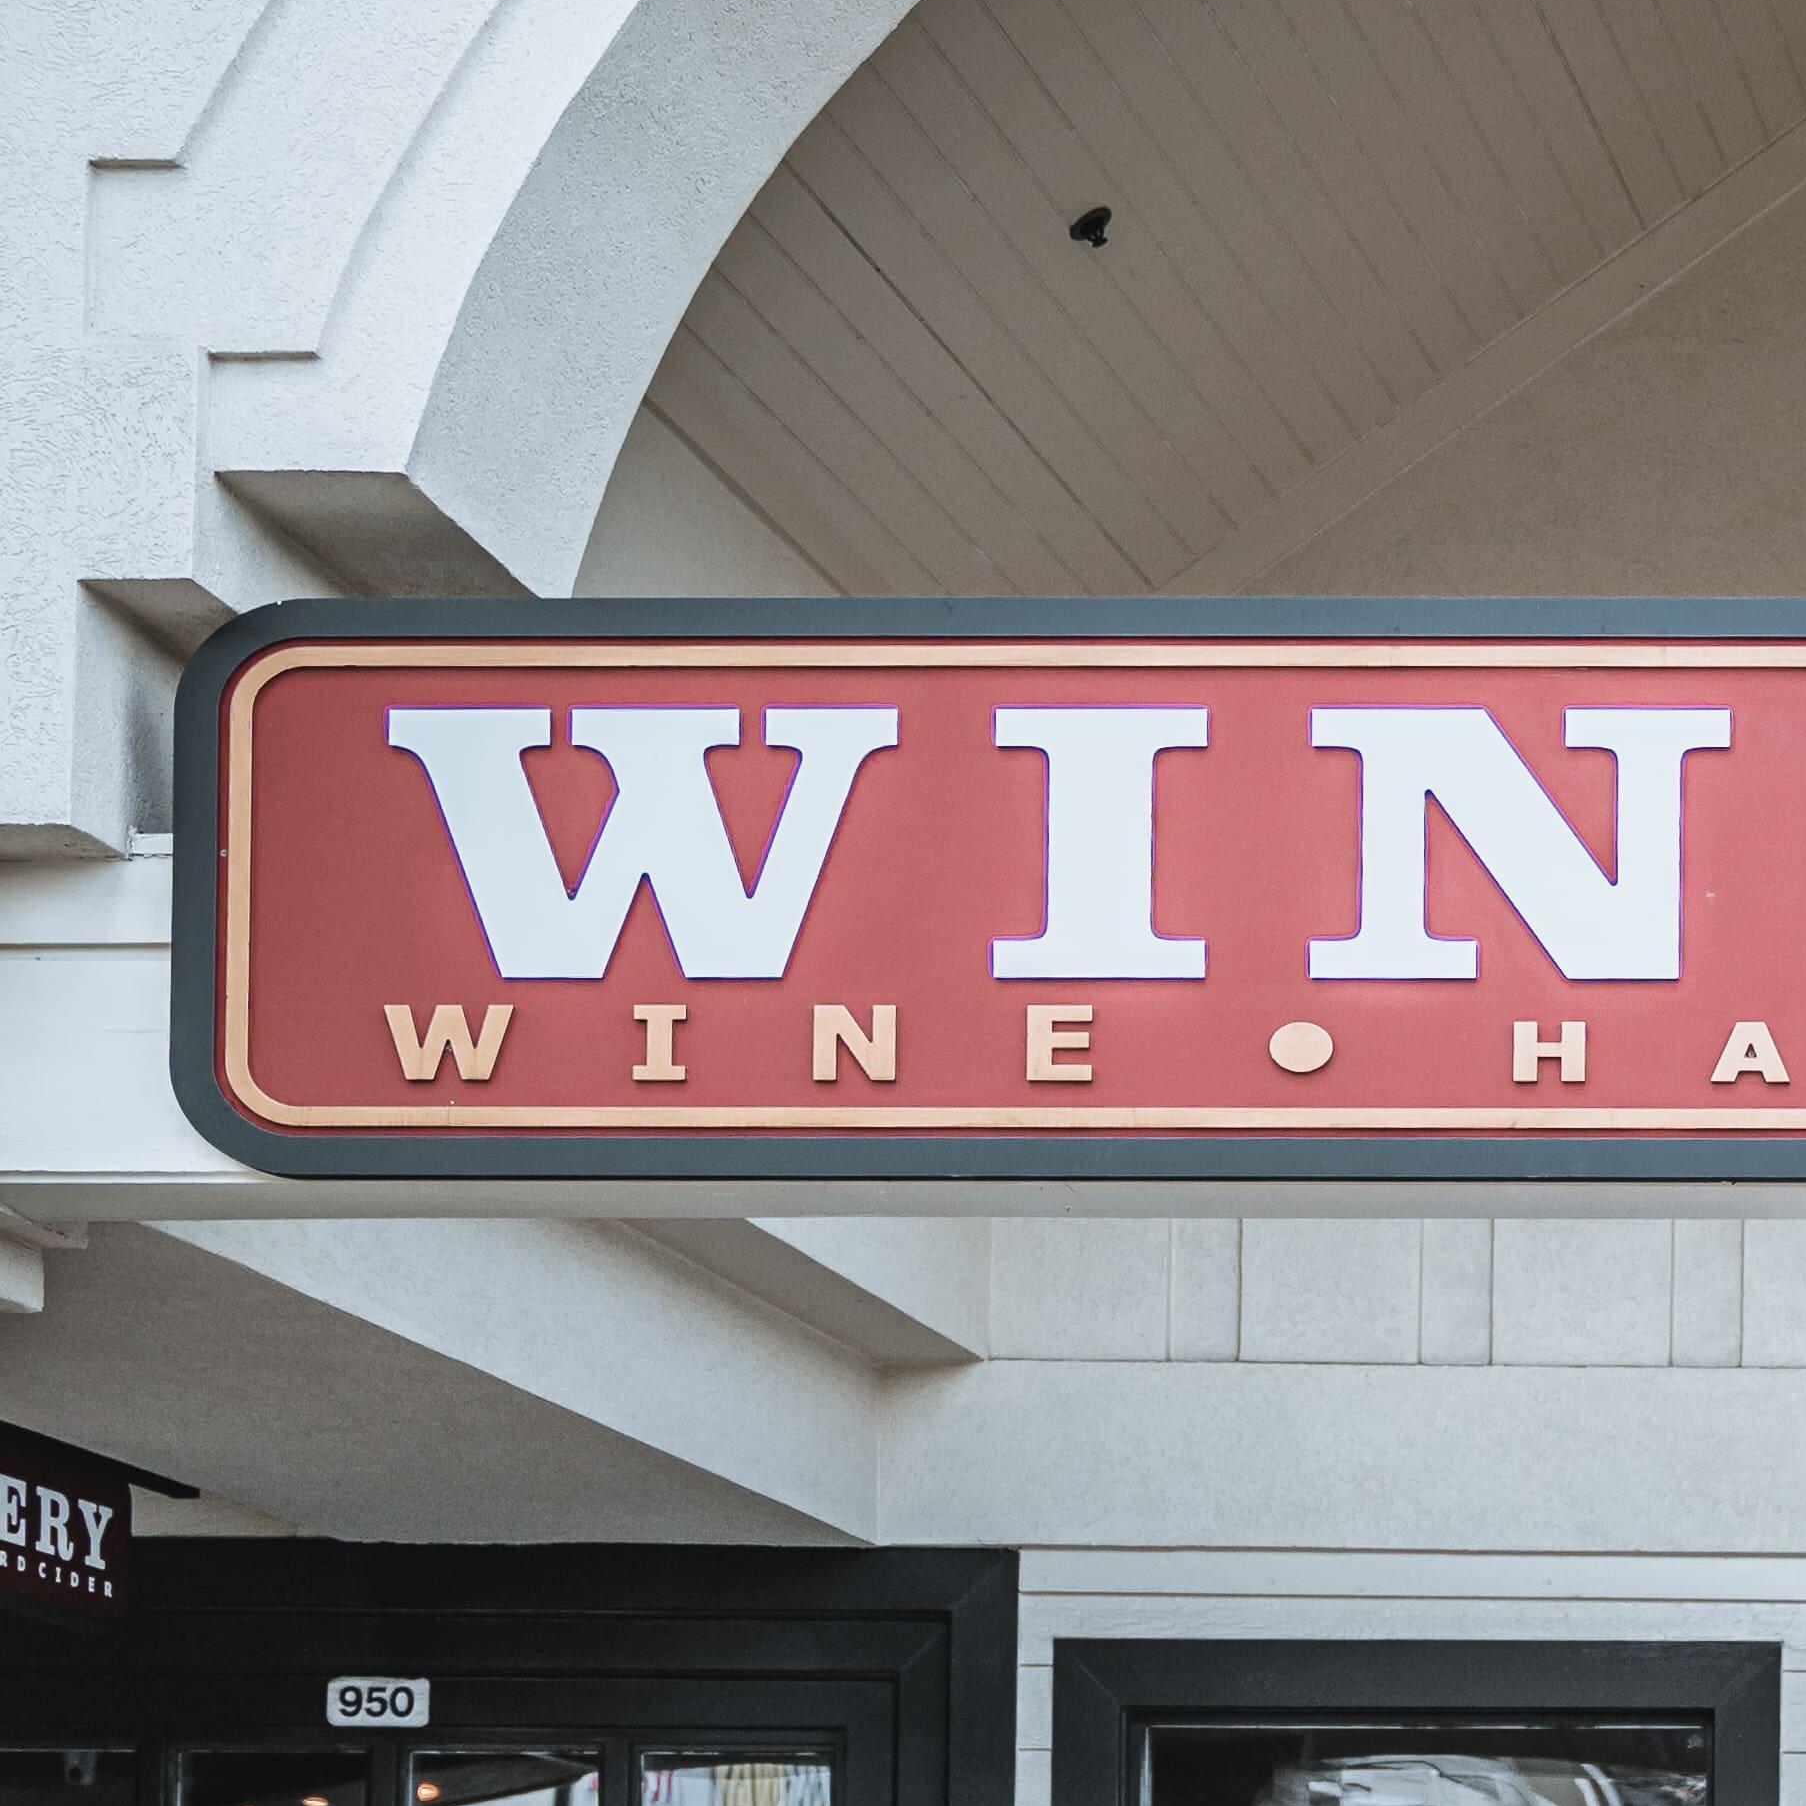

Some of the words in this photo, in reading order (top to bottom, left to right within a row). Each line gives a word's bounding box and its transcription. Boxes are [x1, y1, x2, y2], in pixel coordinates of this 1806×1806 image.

[383, 1003, 1095, 1084] WINE
[0, 1473, 113, 1570] ERY
[38, 1562, 113, 1598] CIDER
[338, 1685, 415, 1718] 950
